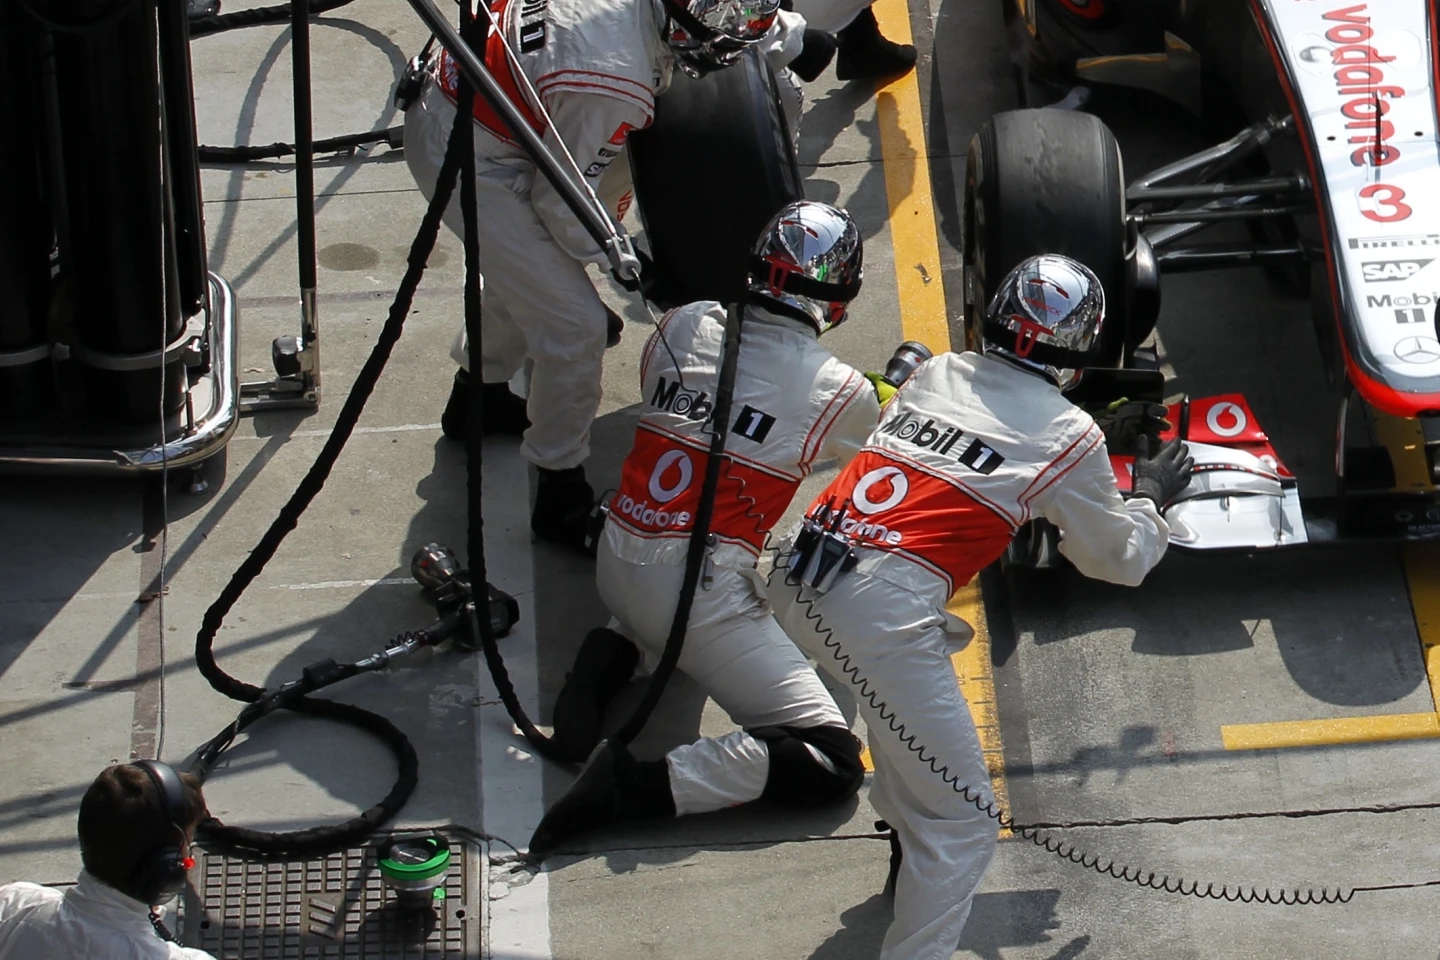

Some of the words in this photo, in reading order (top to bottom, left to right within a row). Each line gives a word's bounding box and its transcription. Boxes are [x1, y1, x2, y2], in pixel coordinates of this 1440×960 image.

[1321, 3, 1406, 167] vodafone
[1359, 183, 1413, 223] 3
[650, 376, 712, 421] Mob
[880, 411, 965, 455] Mobil
